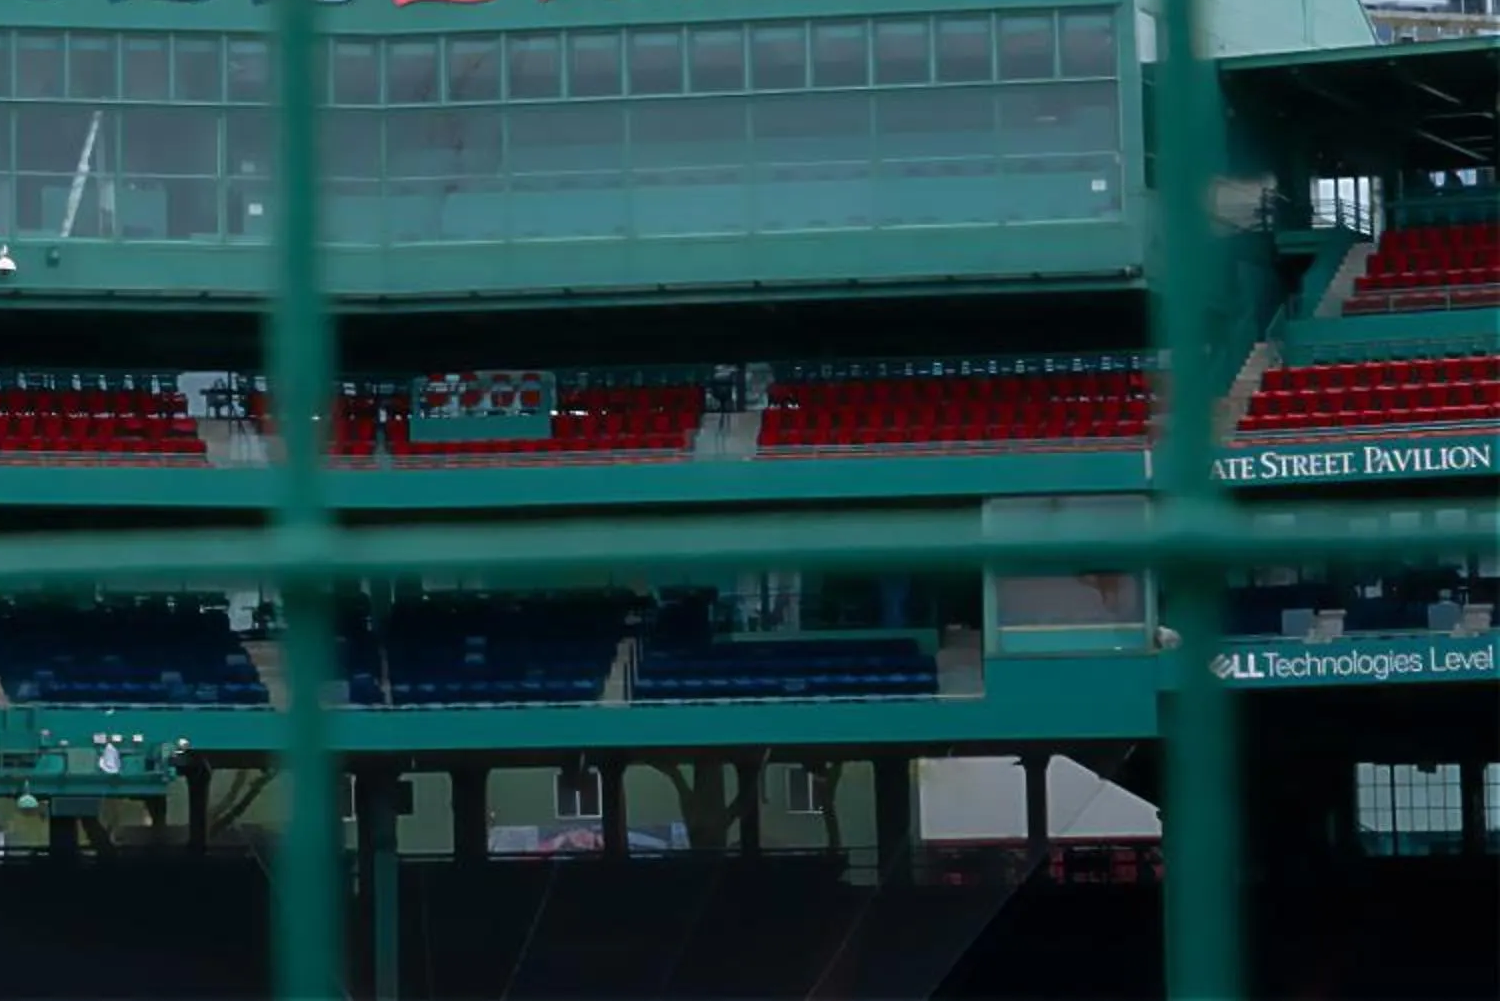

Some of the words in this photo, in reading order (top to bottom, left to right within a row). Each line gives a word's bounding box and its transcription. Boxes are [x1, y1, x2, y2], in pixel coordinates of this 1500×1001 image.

[1211, 457, 1256, 480] ATE
[1260, 451, 1354, 479] STREET
[1363, 445, 1491, 474] PAVILION
[1210, 654, 1264, 678] ELL
[1263, 650, 1423, 679] Technologies
[1430, 645, 1493, 671] Level
